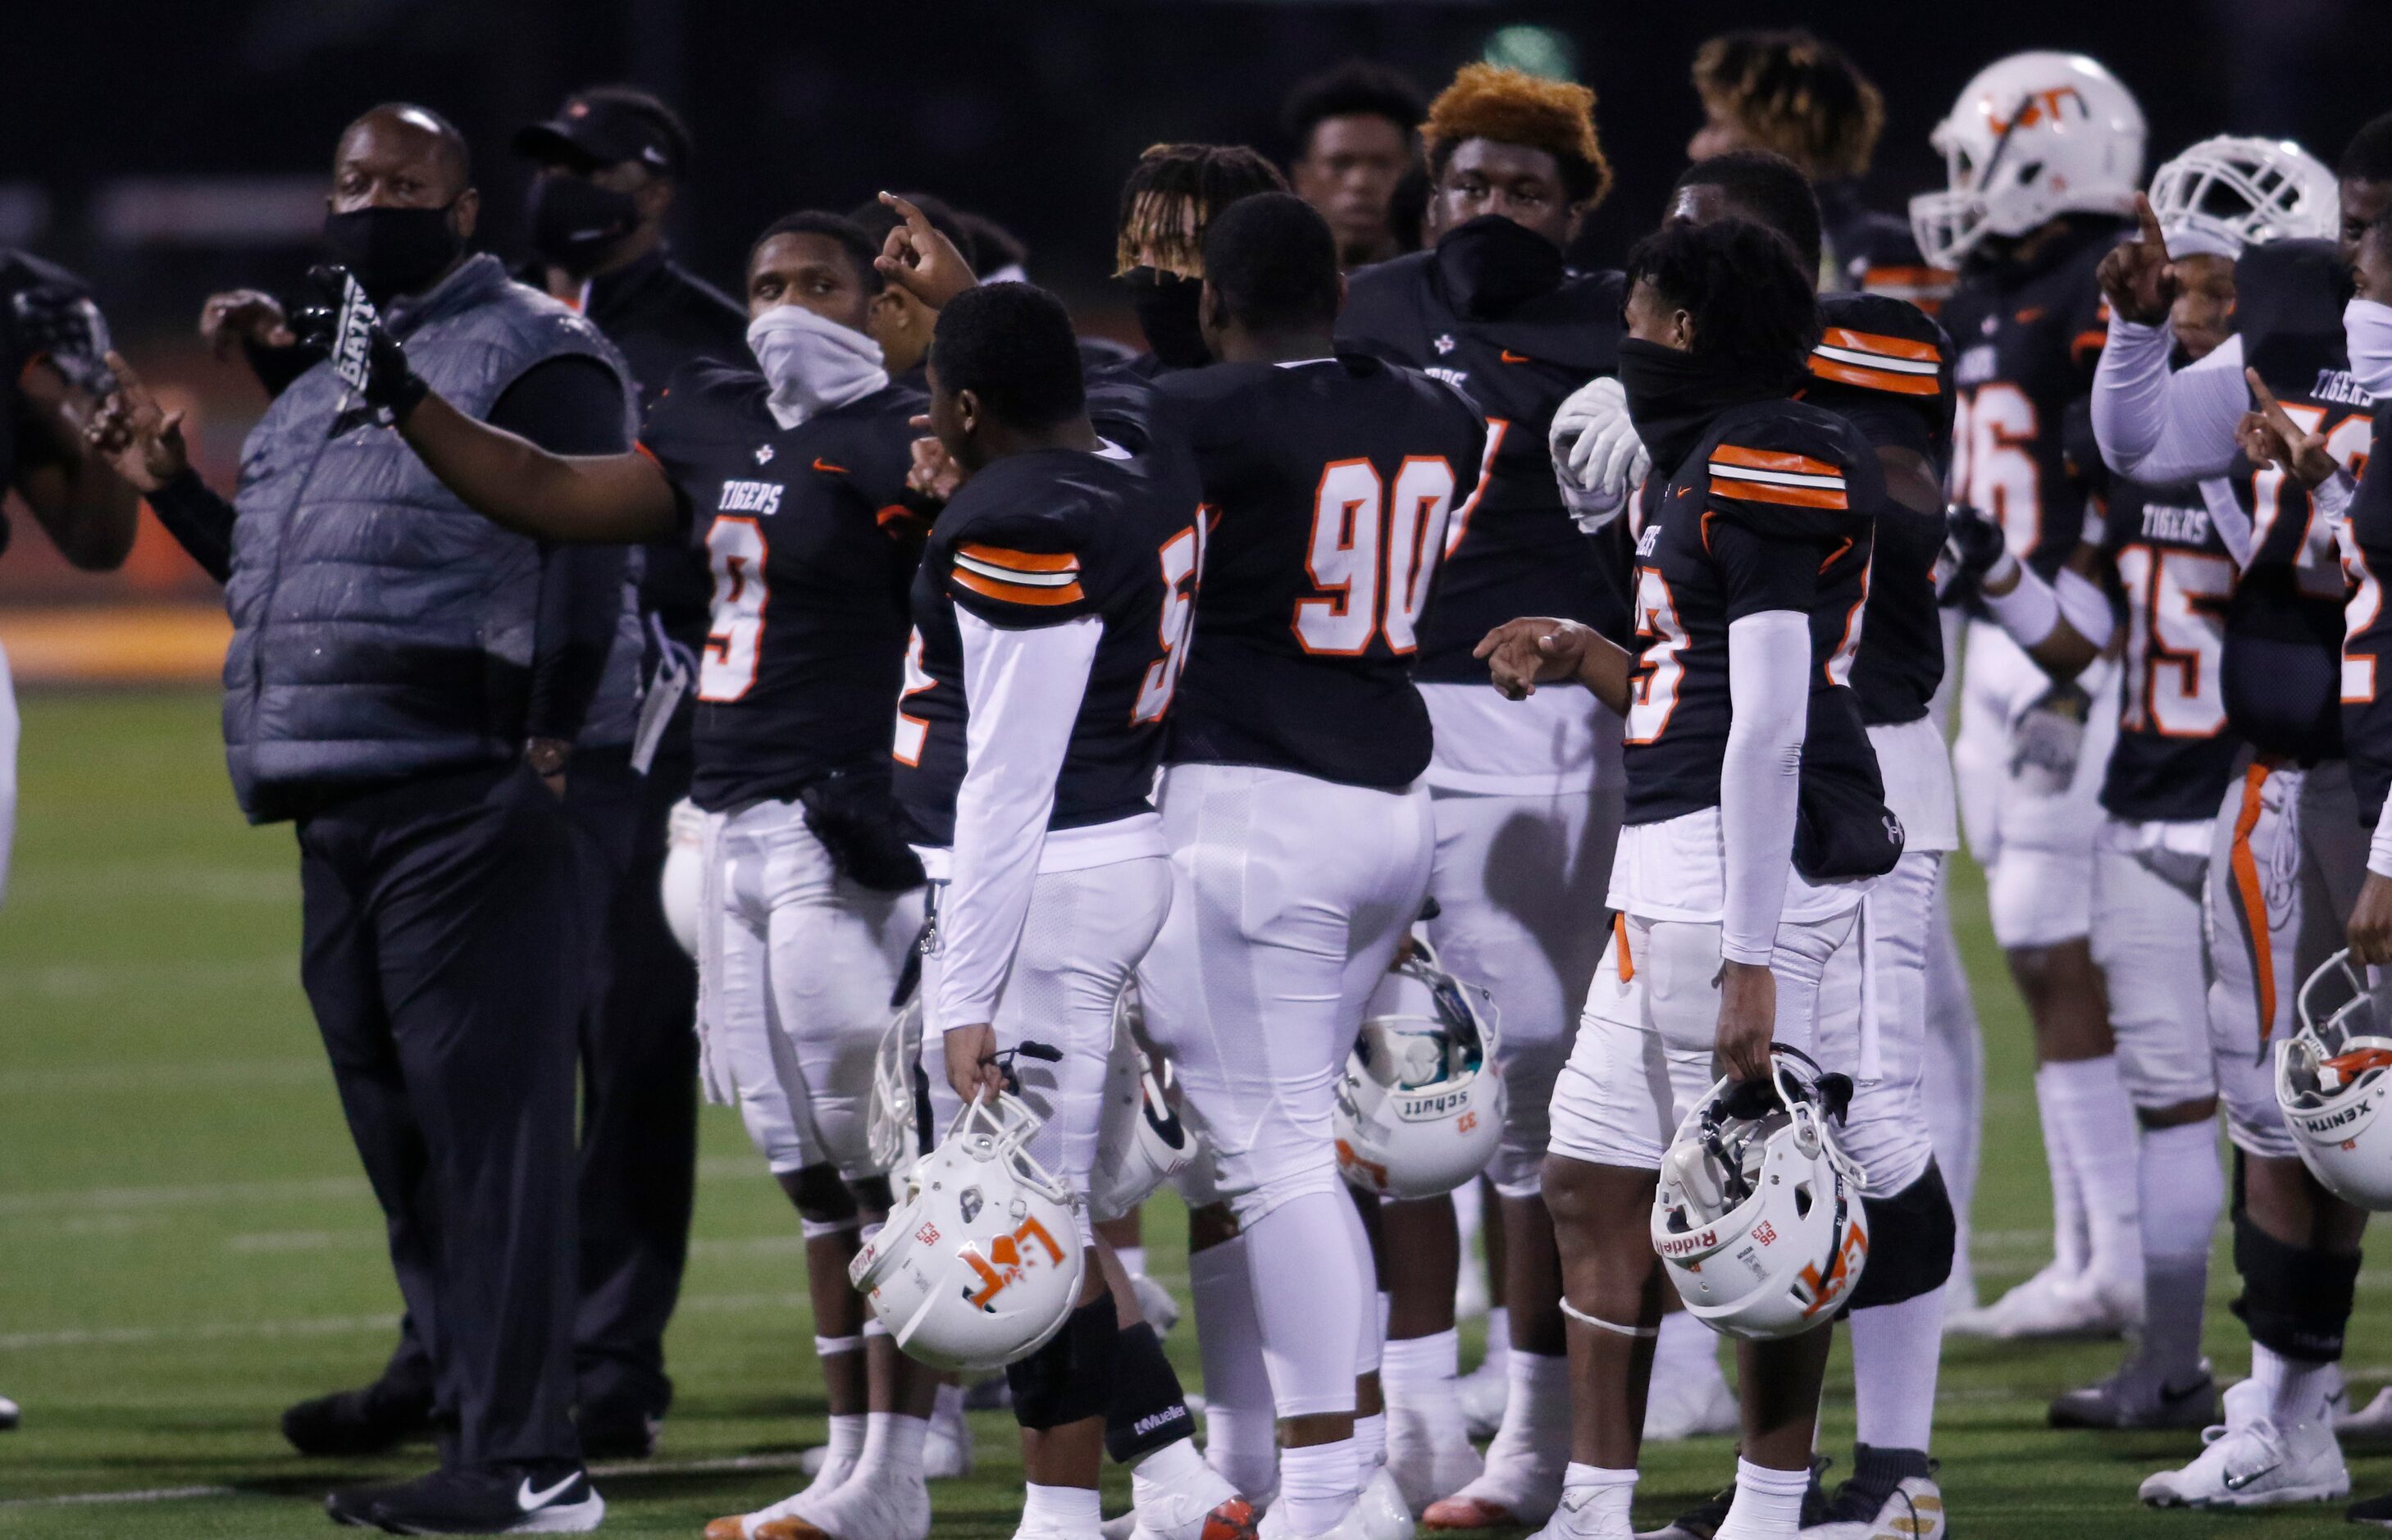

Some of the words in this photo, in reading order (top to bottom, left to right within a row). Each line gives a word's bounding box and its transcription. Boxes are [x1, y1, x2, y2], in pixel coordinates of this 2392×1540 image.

[718, 480, 784, 515] TIGERS
[2140, 503, 2209, 544] TIGERS
[1290, 454, 1456, 656] 90
[697, 514, 770, 703] 9
[1128, 502, 1201, 727] 5
[2115, 542, 2237, 738] 15
[2307, 1099, 2371, 1133] XENITH
[1655, 1229, 1718, 1255] Riddell
[1141, 1406, 1186, 1432] Mueller
